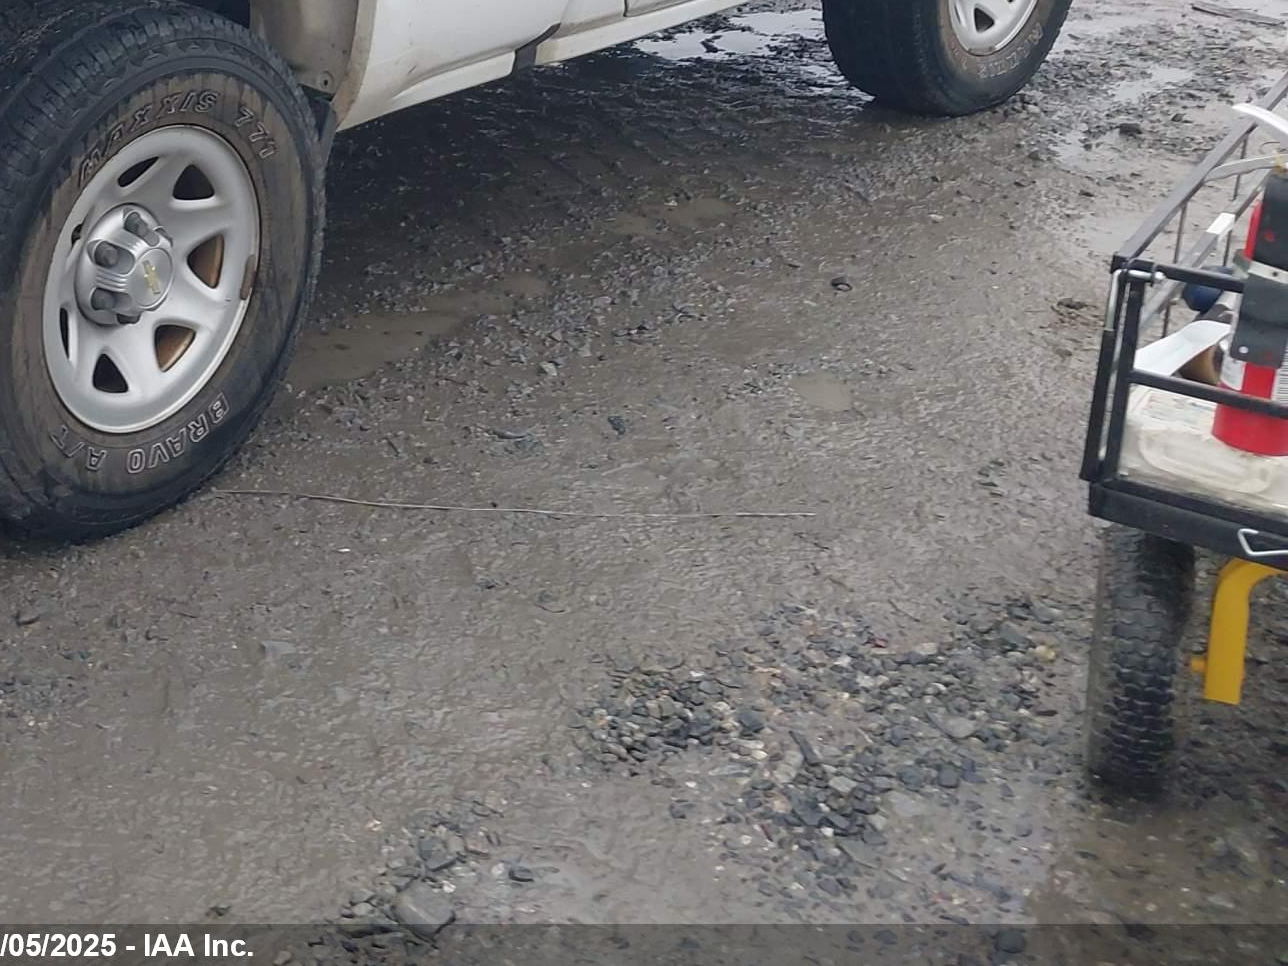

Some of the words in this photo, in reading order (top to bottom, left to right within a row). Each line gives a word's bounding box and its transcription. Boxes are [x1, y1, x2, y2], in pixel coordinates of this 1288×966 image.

[78, 88, 220, 188] MAXXIS
[49, 424, 108, 472] A/T
[126, 391, 231, 475] BRAVO
